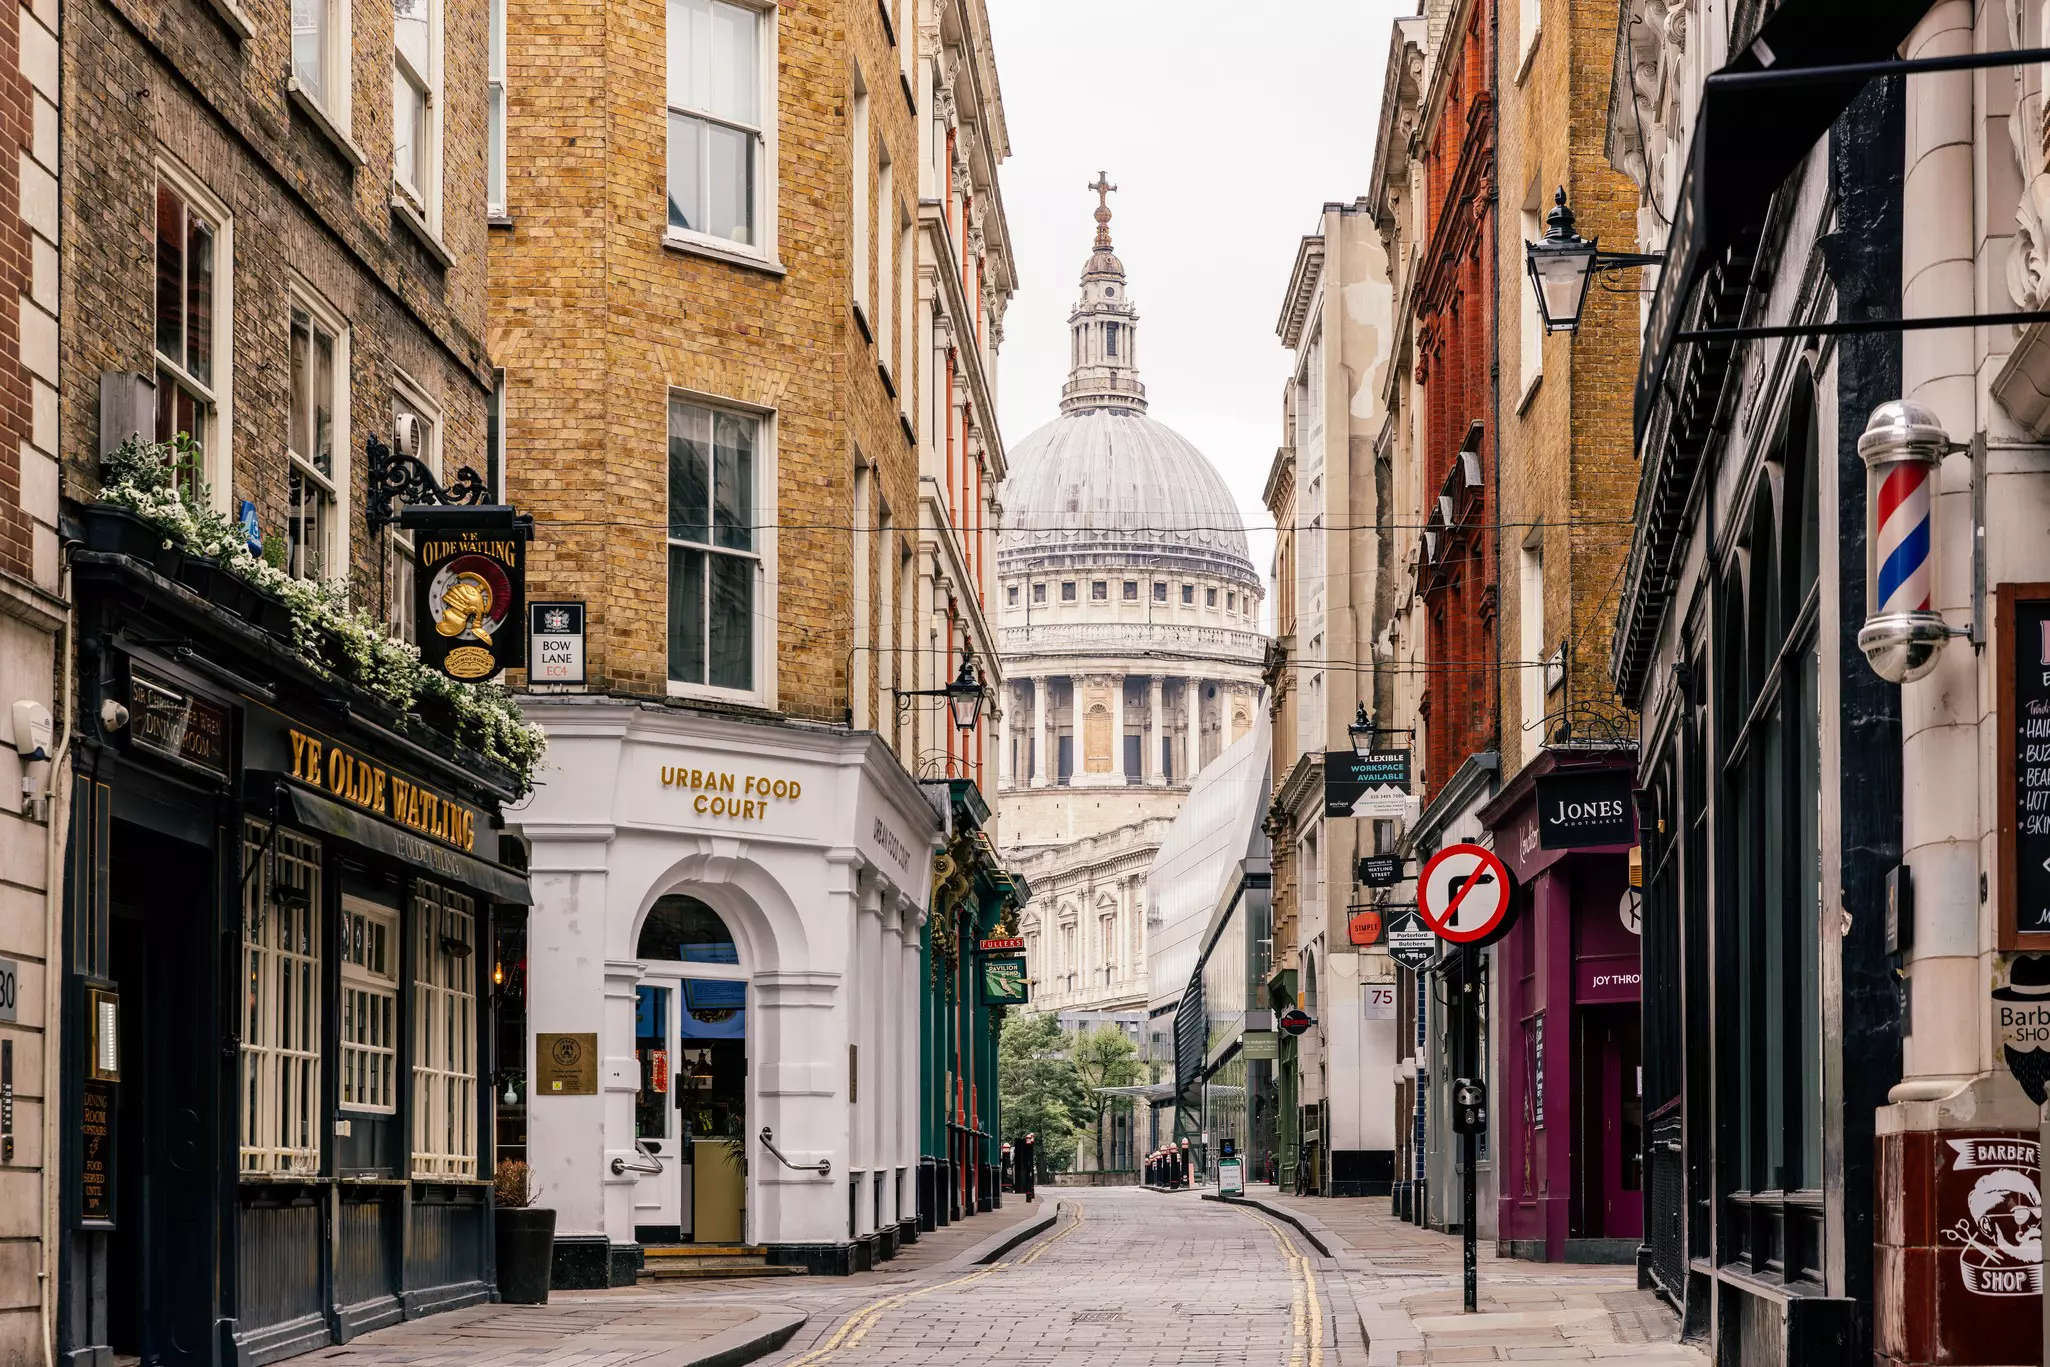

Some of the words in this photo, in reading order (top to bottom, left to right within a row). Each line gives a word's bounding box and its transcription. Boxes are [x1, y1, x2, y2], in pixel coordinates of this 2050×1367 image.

[462, 532, 478, 541] YE
[423, 541, 457, 567] OLDE
[459, 541, 516, 567] WATLING
[543, 641, 571, 651] BOW
[542, 653, 572, 664] LANE
[547, 666, 567, 676] EC4
[133, 682, 146, 704] SIR
[146, 713, 180, 745] DINING
[182, 728, 209, 757] ROOM
[1350, 763, 1404, 772] WORKSPACE
[661, 766, 735, 792] URBAN
[745, 776, 801, 800] FOOD
[1357, 773, 1404, 781] AVAILABLE
[290, 729, 322, 788] YE
[329, 748, 386, 815] OLDE
[392, 776, 475, 852] WATLING
[693, 795, 768, 820] COURT
[2026, 791, 2050, 811] HOT
[1550, 800, 1623, 824] JONES
[1564, 818, 1623, 827] BOOTMAKER
[394, 833, 405, 855] YE
[406, 838, 427, 863] OLDE
[1354, 923, 1378, 932] SIMPLE
[982, 939, 1021, 948] FULLER'S
[1593, 975, 1610, 987] JOY
[1612, 974, 1642, 985] THRO
[1372, 990, 1393, 1004] 75
[2001, 1005, 2050, 1026] Barb
[2016, 1027, 2049, 1041] SHO
[84, 1092, 107, 1108] DINING
[84, 1108, 106, 1124] ROOM
[83, 1125, 107, 1136] UPSTAIRS
[1977, 1145, 2035, 1163] BARBER
[86, 1160, 103, 1171] FOOD
[83, 1173, 105, 1183] SERVED
[1981, 1271, 2027, 1291] SHOP
